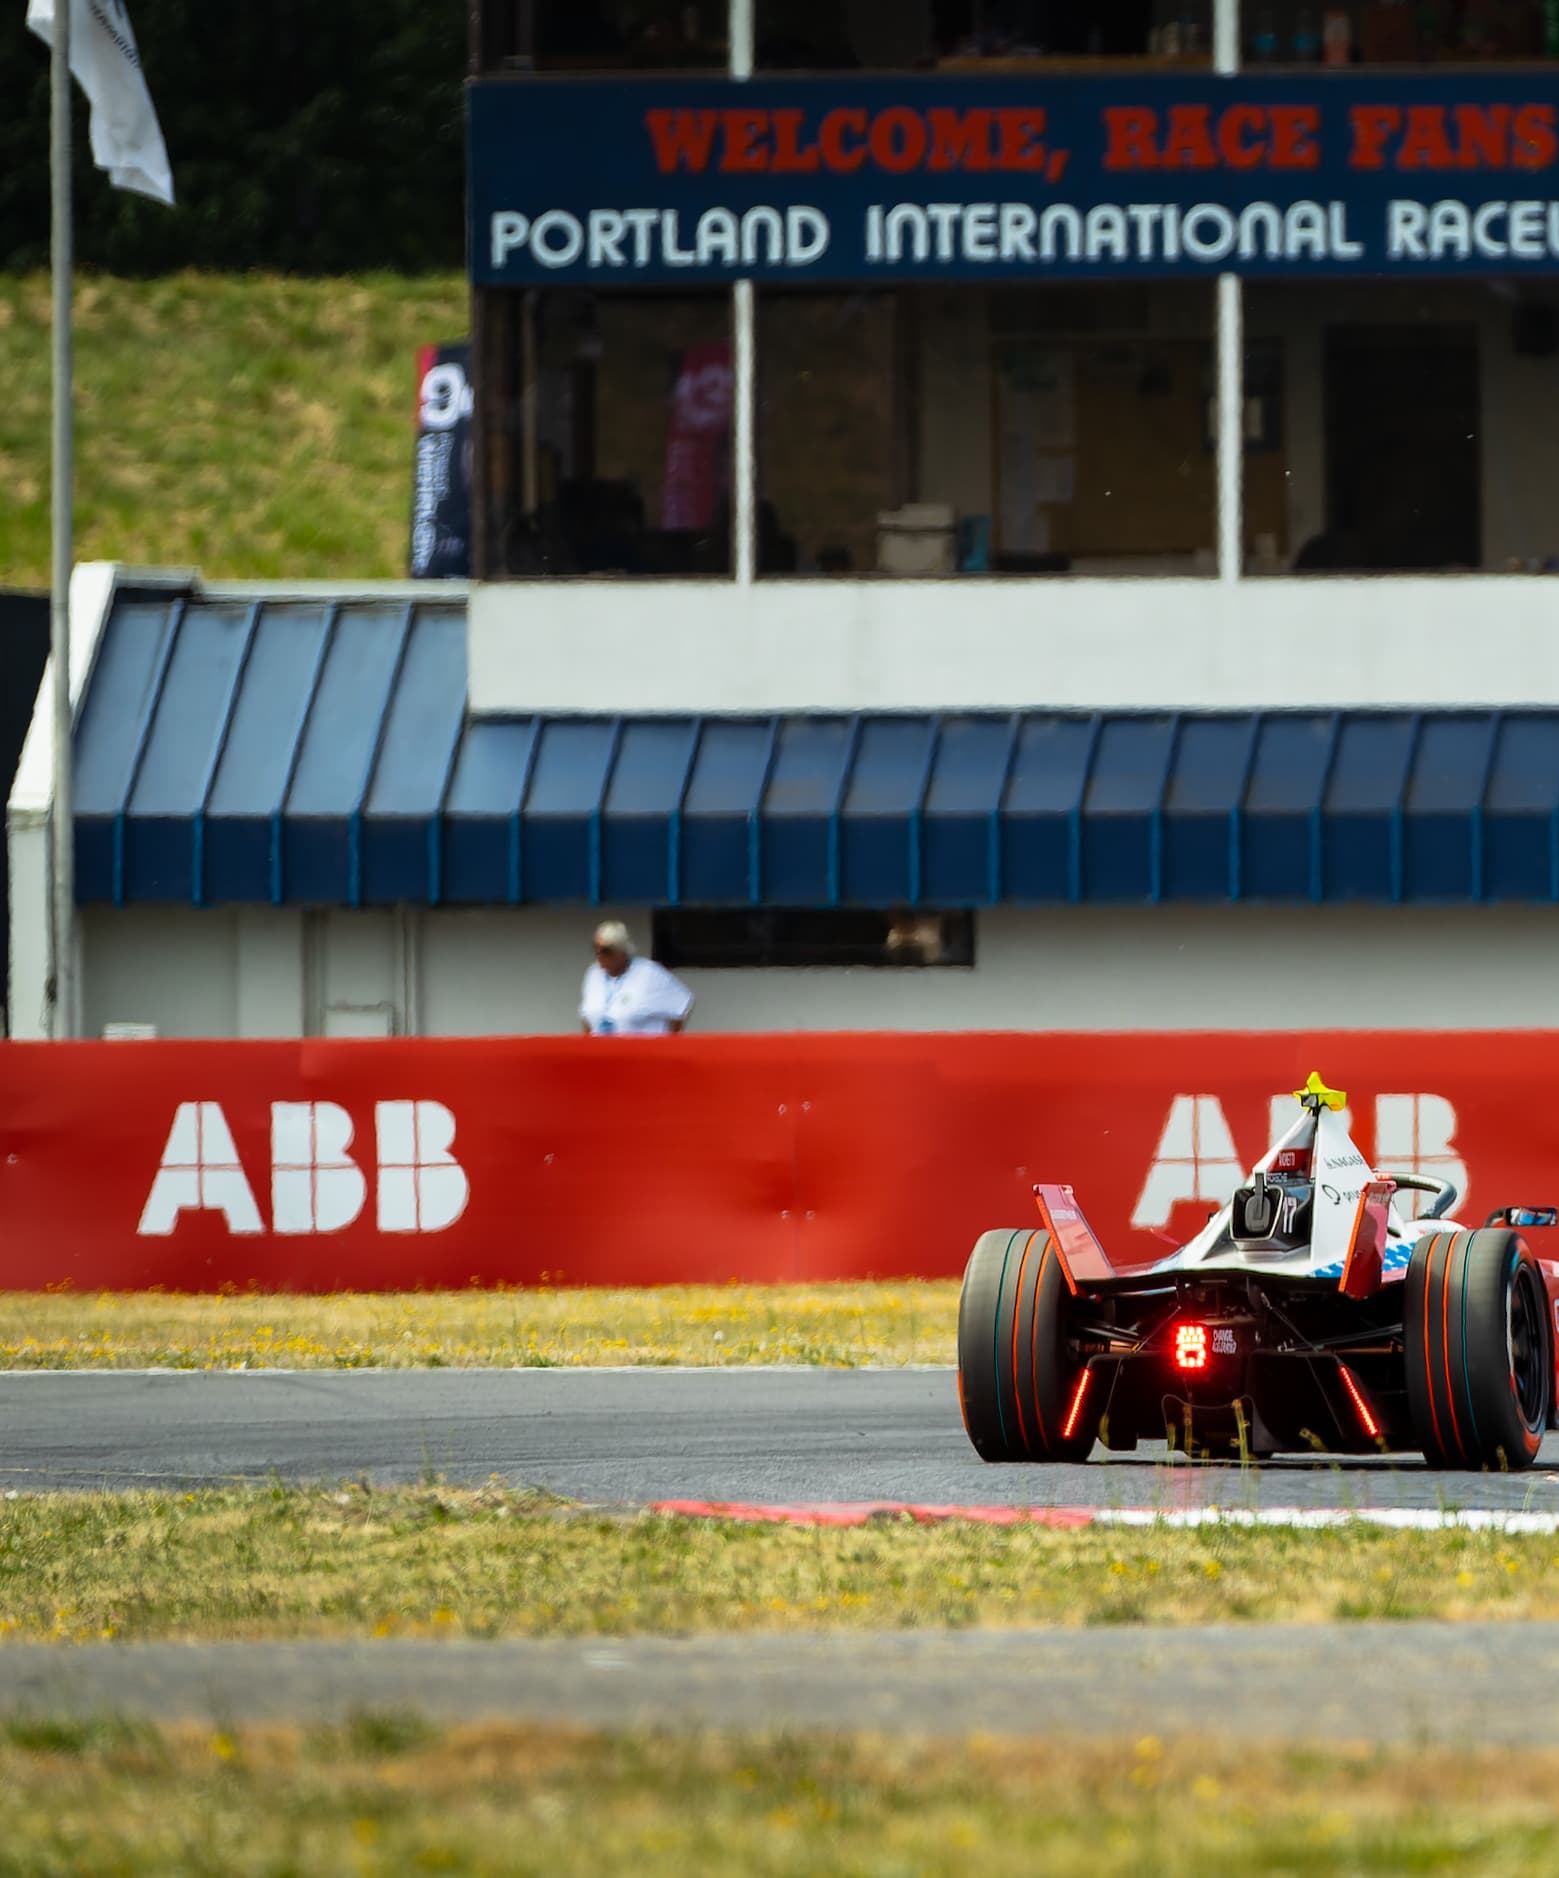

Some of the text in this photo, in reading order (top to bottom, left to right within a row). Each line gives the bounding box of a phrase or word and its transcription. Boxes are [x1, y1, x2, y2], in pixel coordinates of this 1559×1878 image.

[647, 103, 1557, 182] WELCOME, RACE FANS
[491, 208, 829, 268] PORTLAND
[865, 202, 1363, 264] INTERNATIONAL
[137, 1099, 470, 1236] ABB
